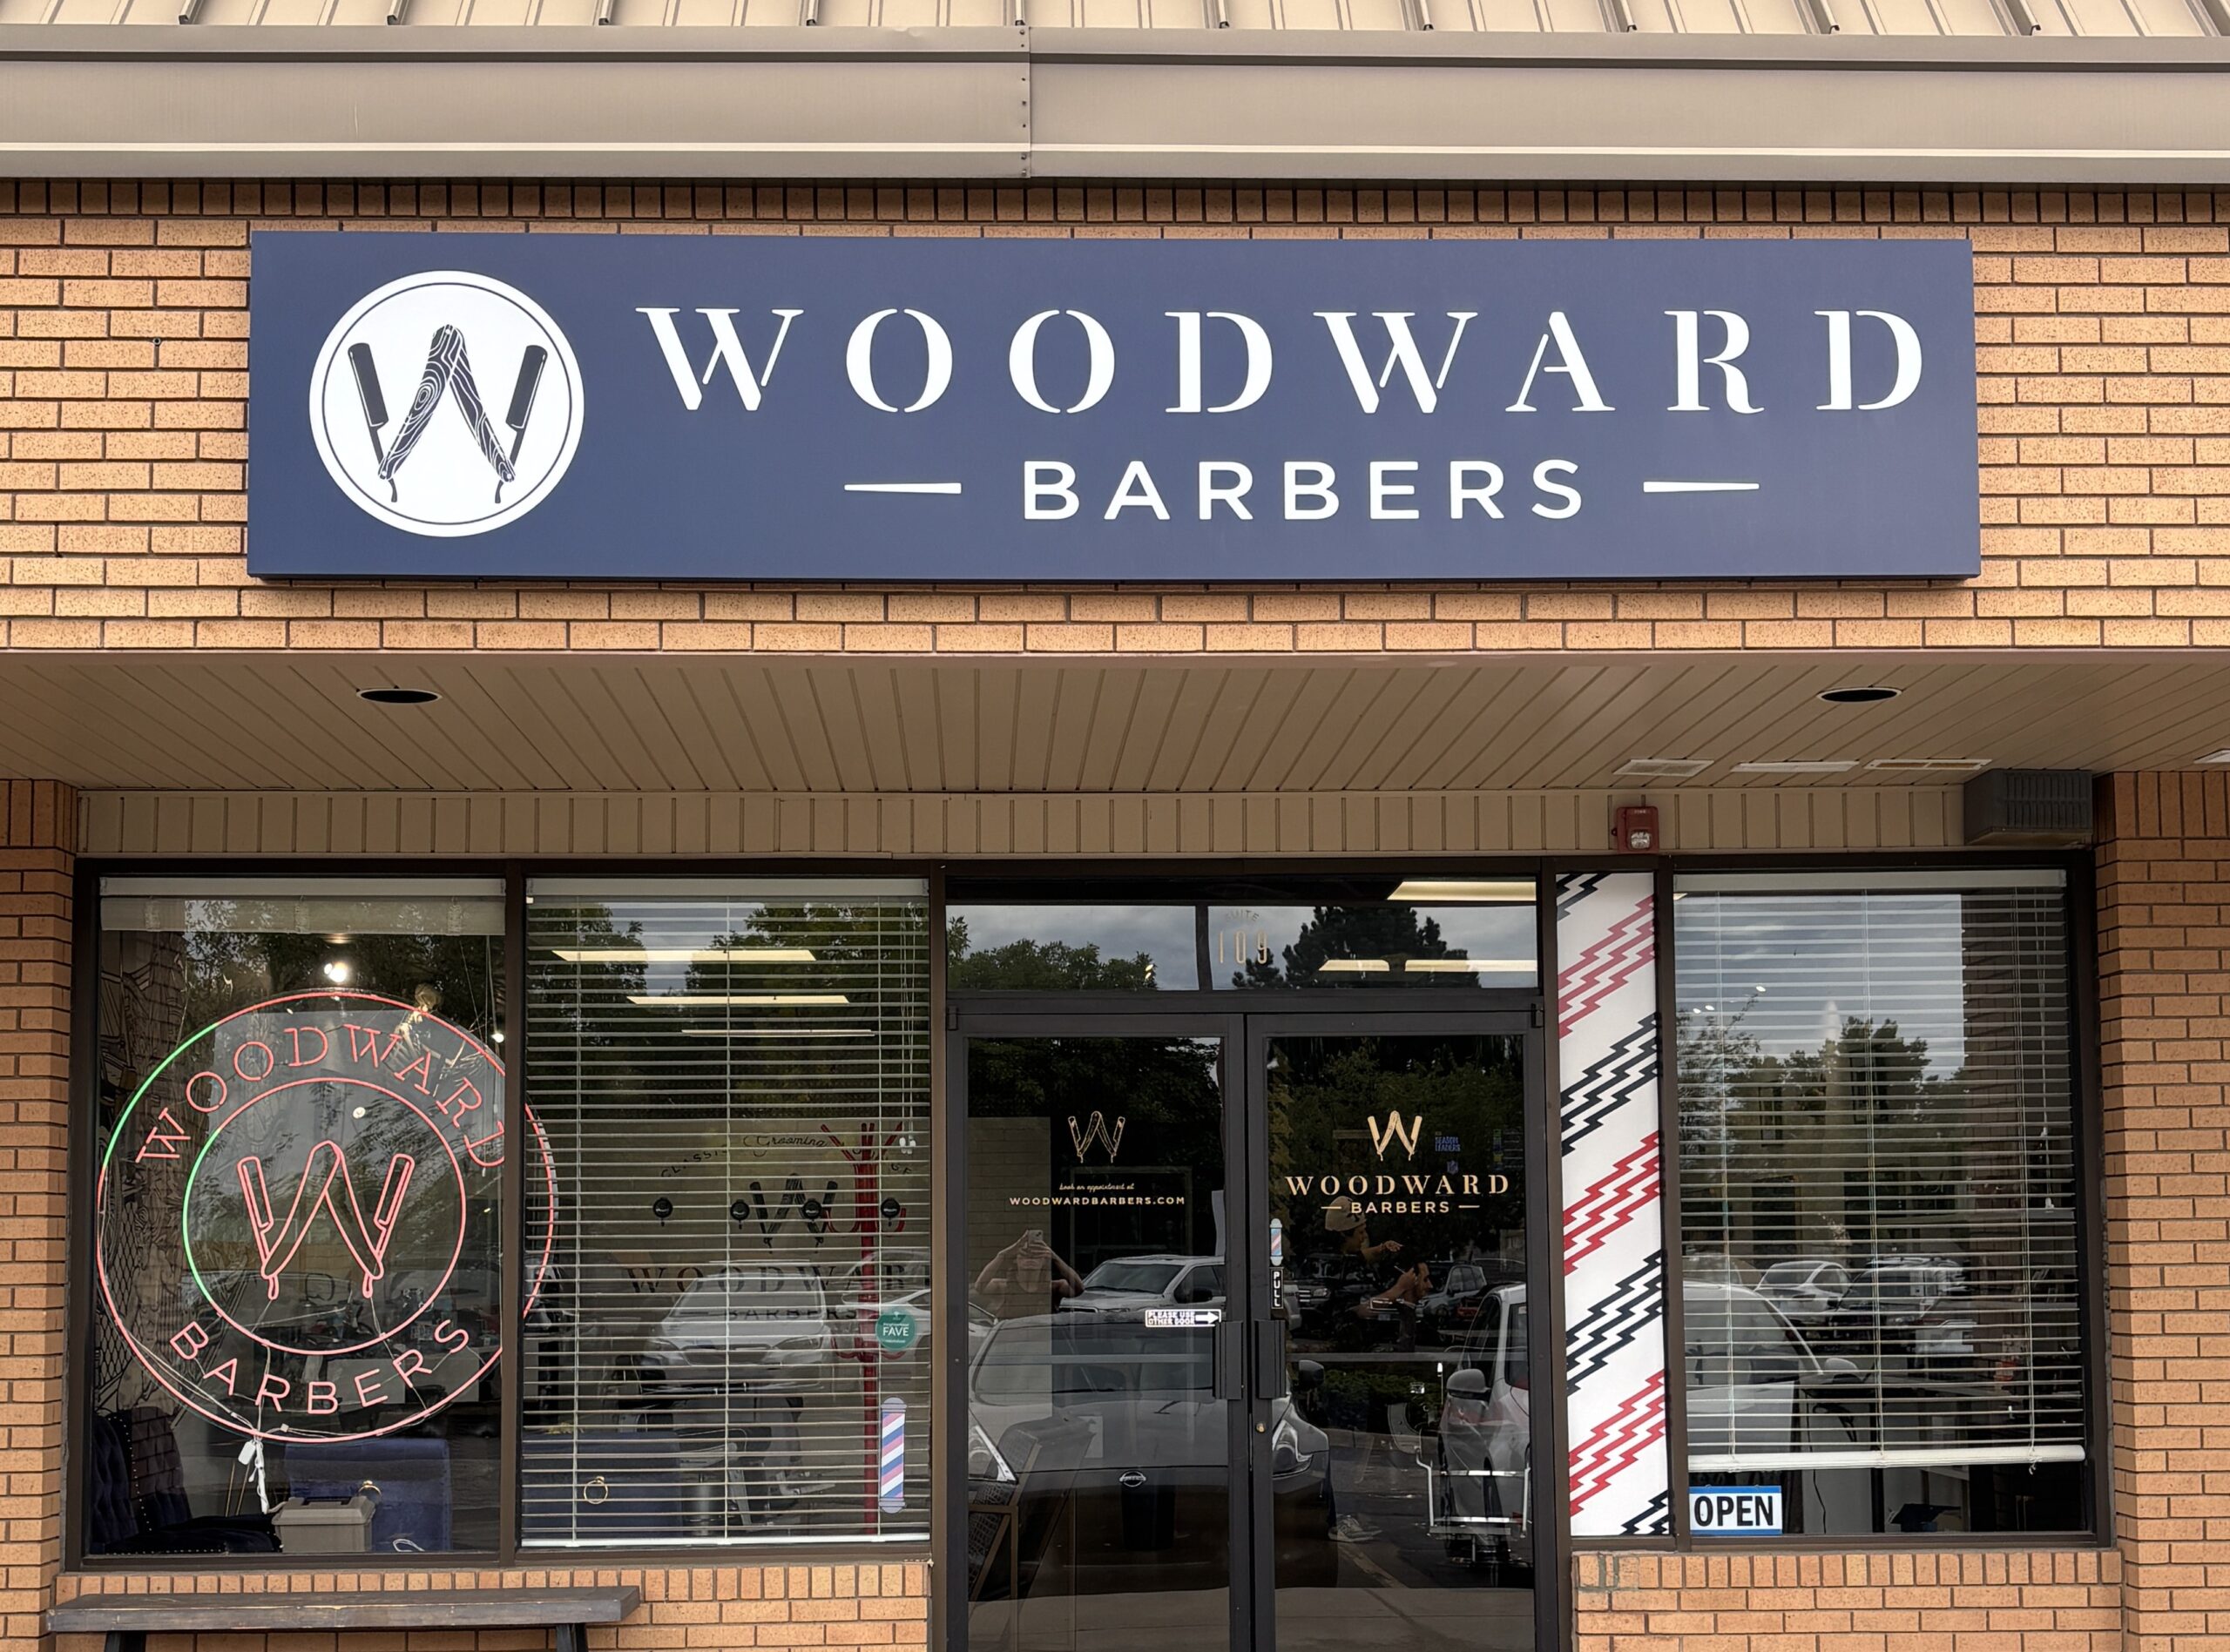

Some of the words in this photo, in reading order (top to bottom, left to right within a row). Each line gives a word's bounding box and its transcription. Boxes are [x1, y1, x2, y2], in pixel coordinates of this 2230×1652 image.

[635, 306, 1923, 416] WOODWARD
[1024, 459, 1583, 521] BARBERS
[1219, 929, 1268, 964] 109
[1009, 1197, 1186, 1205] WOODWARDBARBERS.COM
[1285, 1174, 1509, 1197] WOODWARD
[1350, 1201, 1450, 1214] BARBERS
[882, 1326, 909, 1337] FAVE
[169, 1318, 470, 1416] BARBERS
[1694, 1495, 1774, 1527] OPEN
